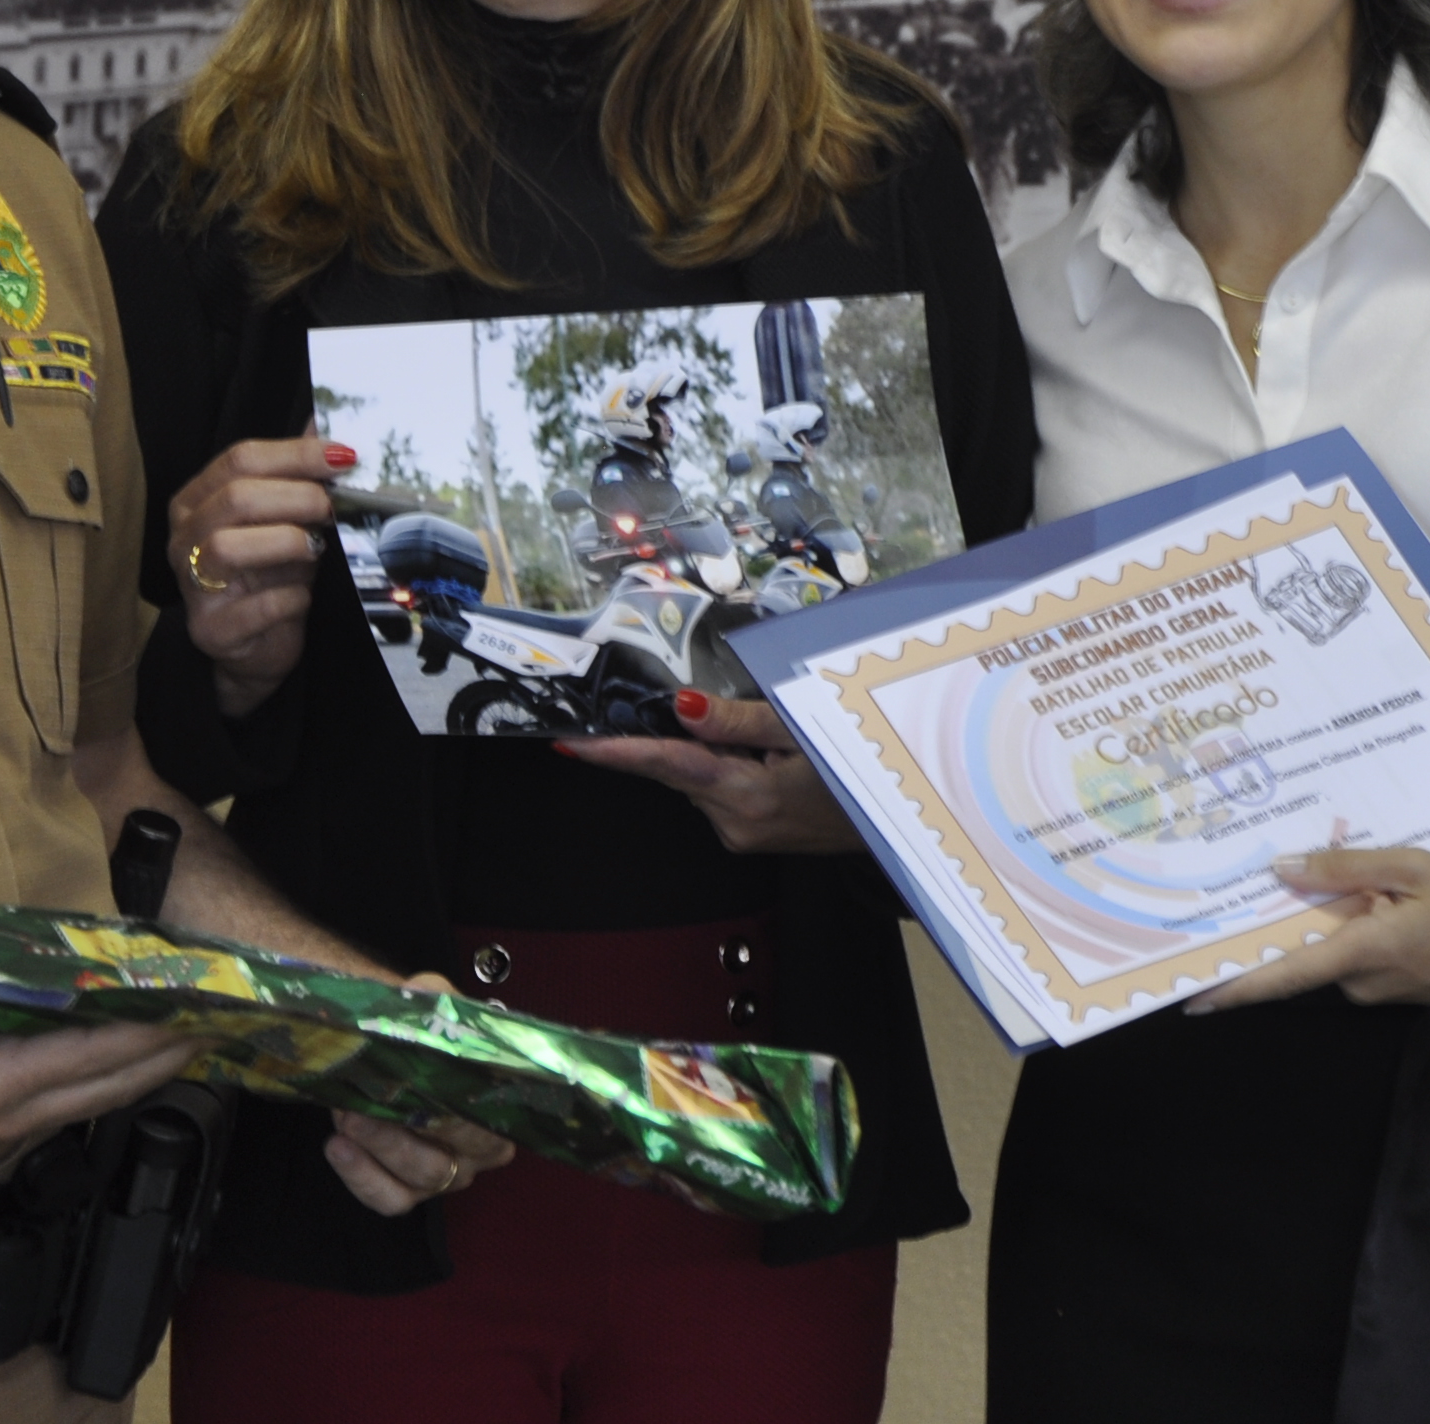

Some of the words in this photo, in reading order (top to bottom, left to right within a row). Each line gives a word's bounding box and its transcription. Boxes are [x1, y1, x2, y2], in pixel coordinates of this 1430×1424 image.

[479, 633, 517, 655] 2636
[975, 635, 1058, 673] POLÍCIA
[1058, 605, 1139, 645] MILITAR
[1139, 591, 1171, 614] DO
[1171, 561, 1252, 603] PARANÁ
[1029, 624, 1168, 687] SUBCOMANDO
[1170, 600, 1238, 637] GERAL
[1131, 652, 1161, 679] DE
[1161, 621, 1263, 669] PATRULHA
[1054, 695, 1148, 741] ESCOLAR
[1148, 648, 1278, 706] COMUNITÁRIA
[1094, 683, 1280, 765] Certificado
[1157, 765, 1208, 795] ESCOLAR
[1206, 738, 1287, 773] COMUNITÁRIA
[1330, 705, 1382, 730] AMANDA
[1068, 838, 1107, 861] MELO
[1321, 745, 1362, 768] Cultural
[1247, 810, 1270, 827] SEU
